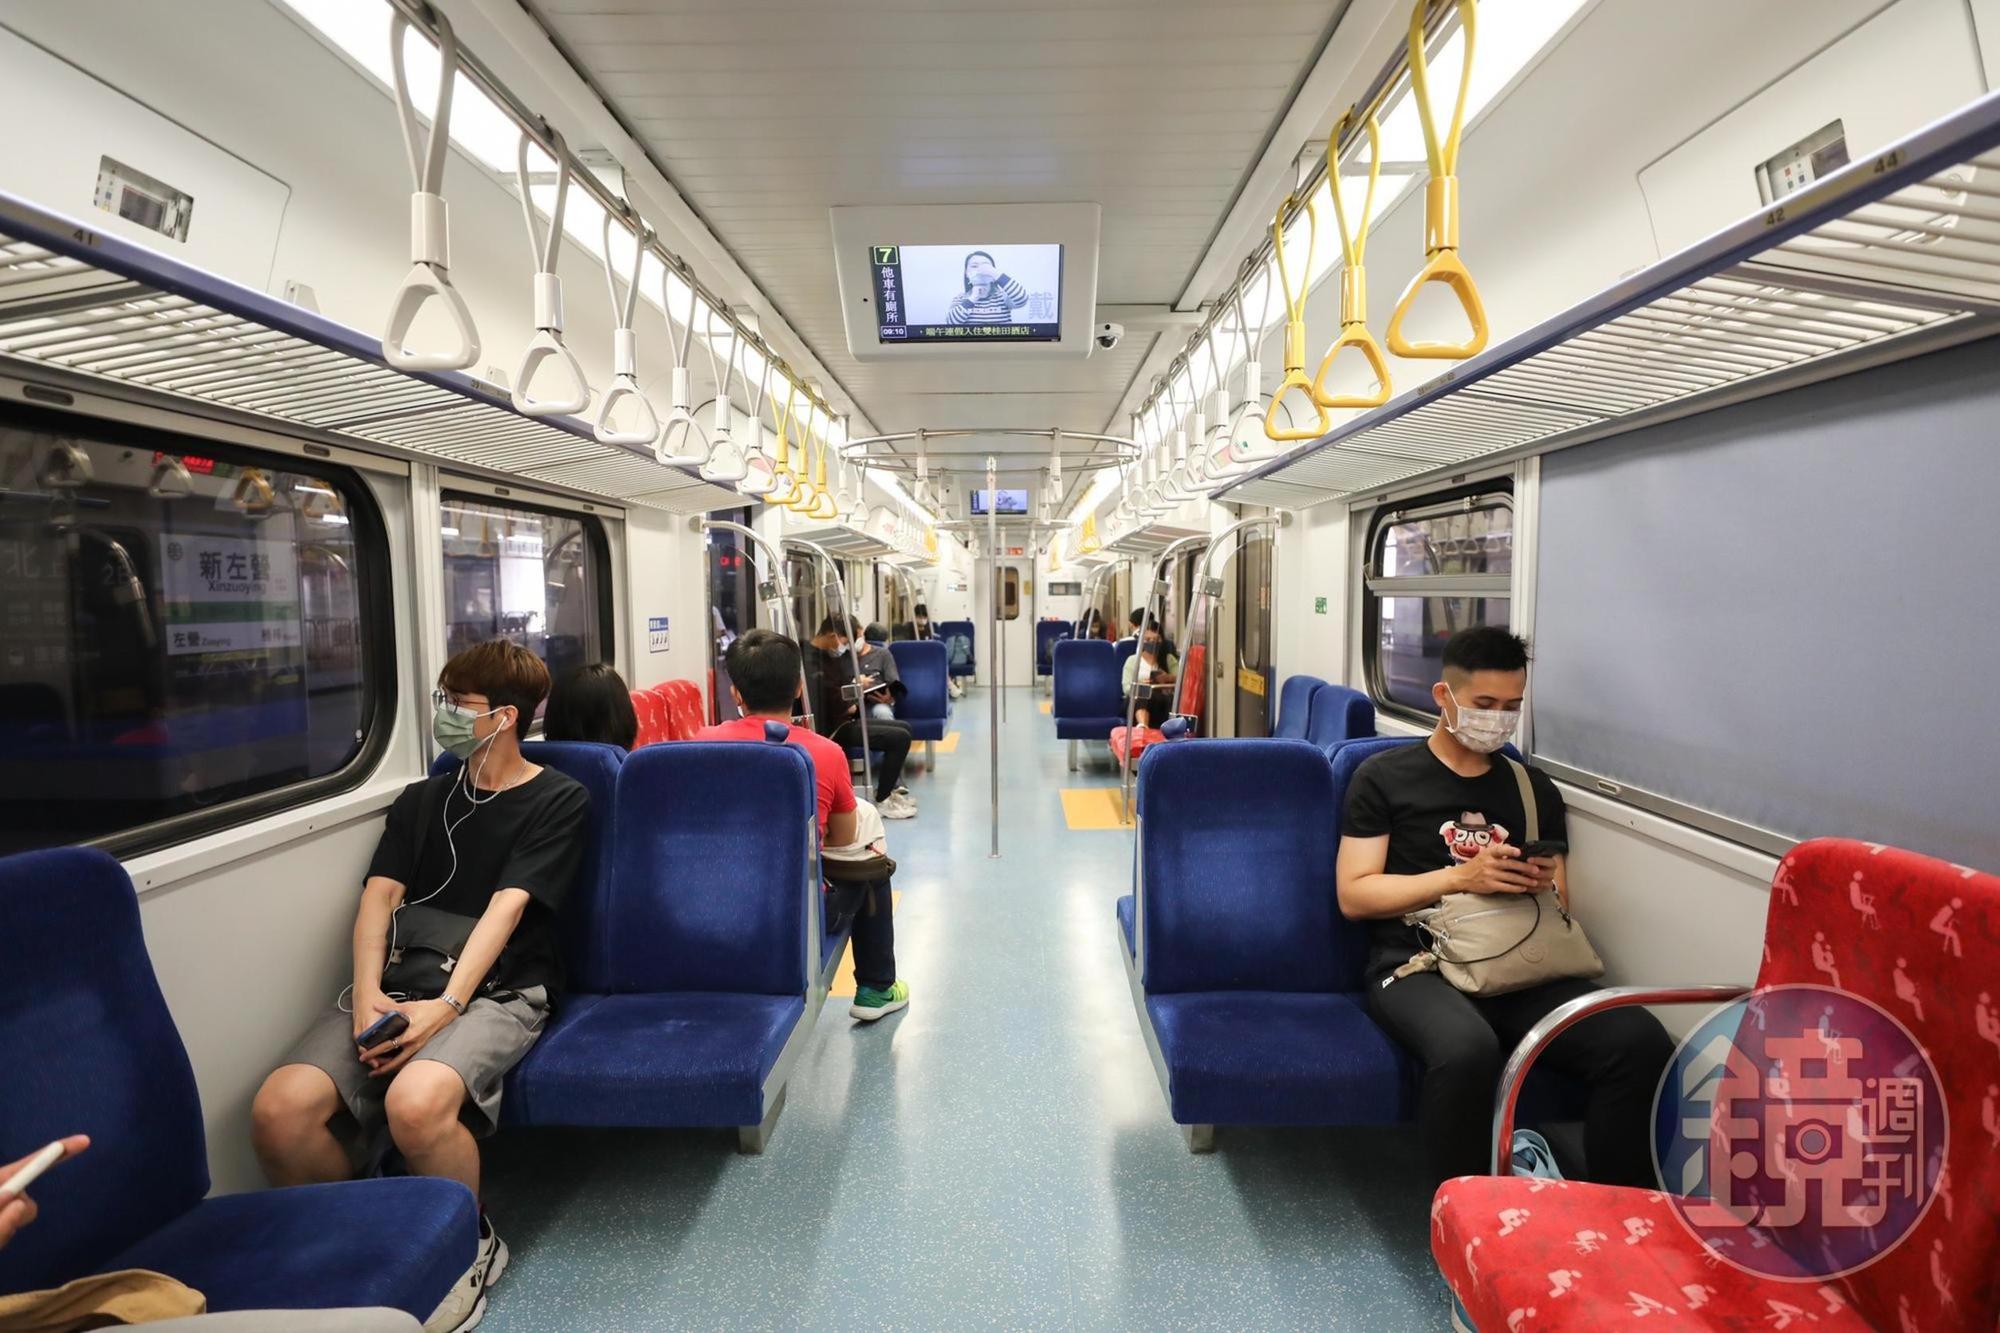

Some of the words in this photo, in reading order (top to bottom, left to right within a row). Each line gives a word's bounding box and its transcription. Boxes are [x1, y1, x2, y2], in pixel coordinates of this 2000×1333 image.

[1874, 152, 1897, 173] 44
[1766, 209, 1784, 226] 42
[73, 229, 93, 245] 41
[879, 248, 892, 263] 7
[881, 266, 898, 323] 他車有廁所
[200, 551, 270, 581] 新左營
